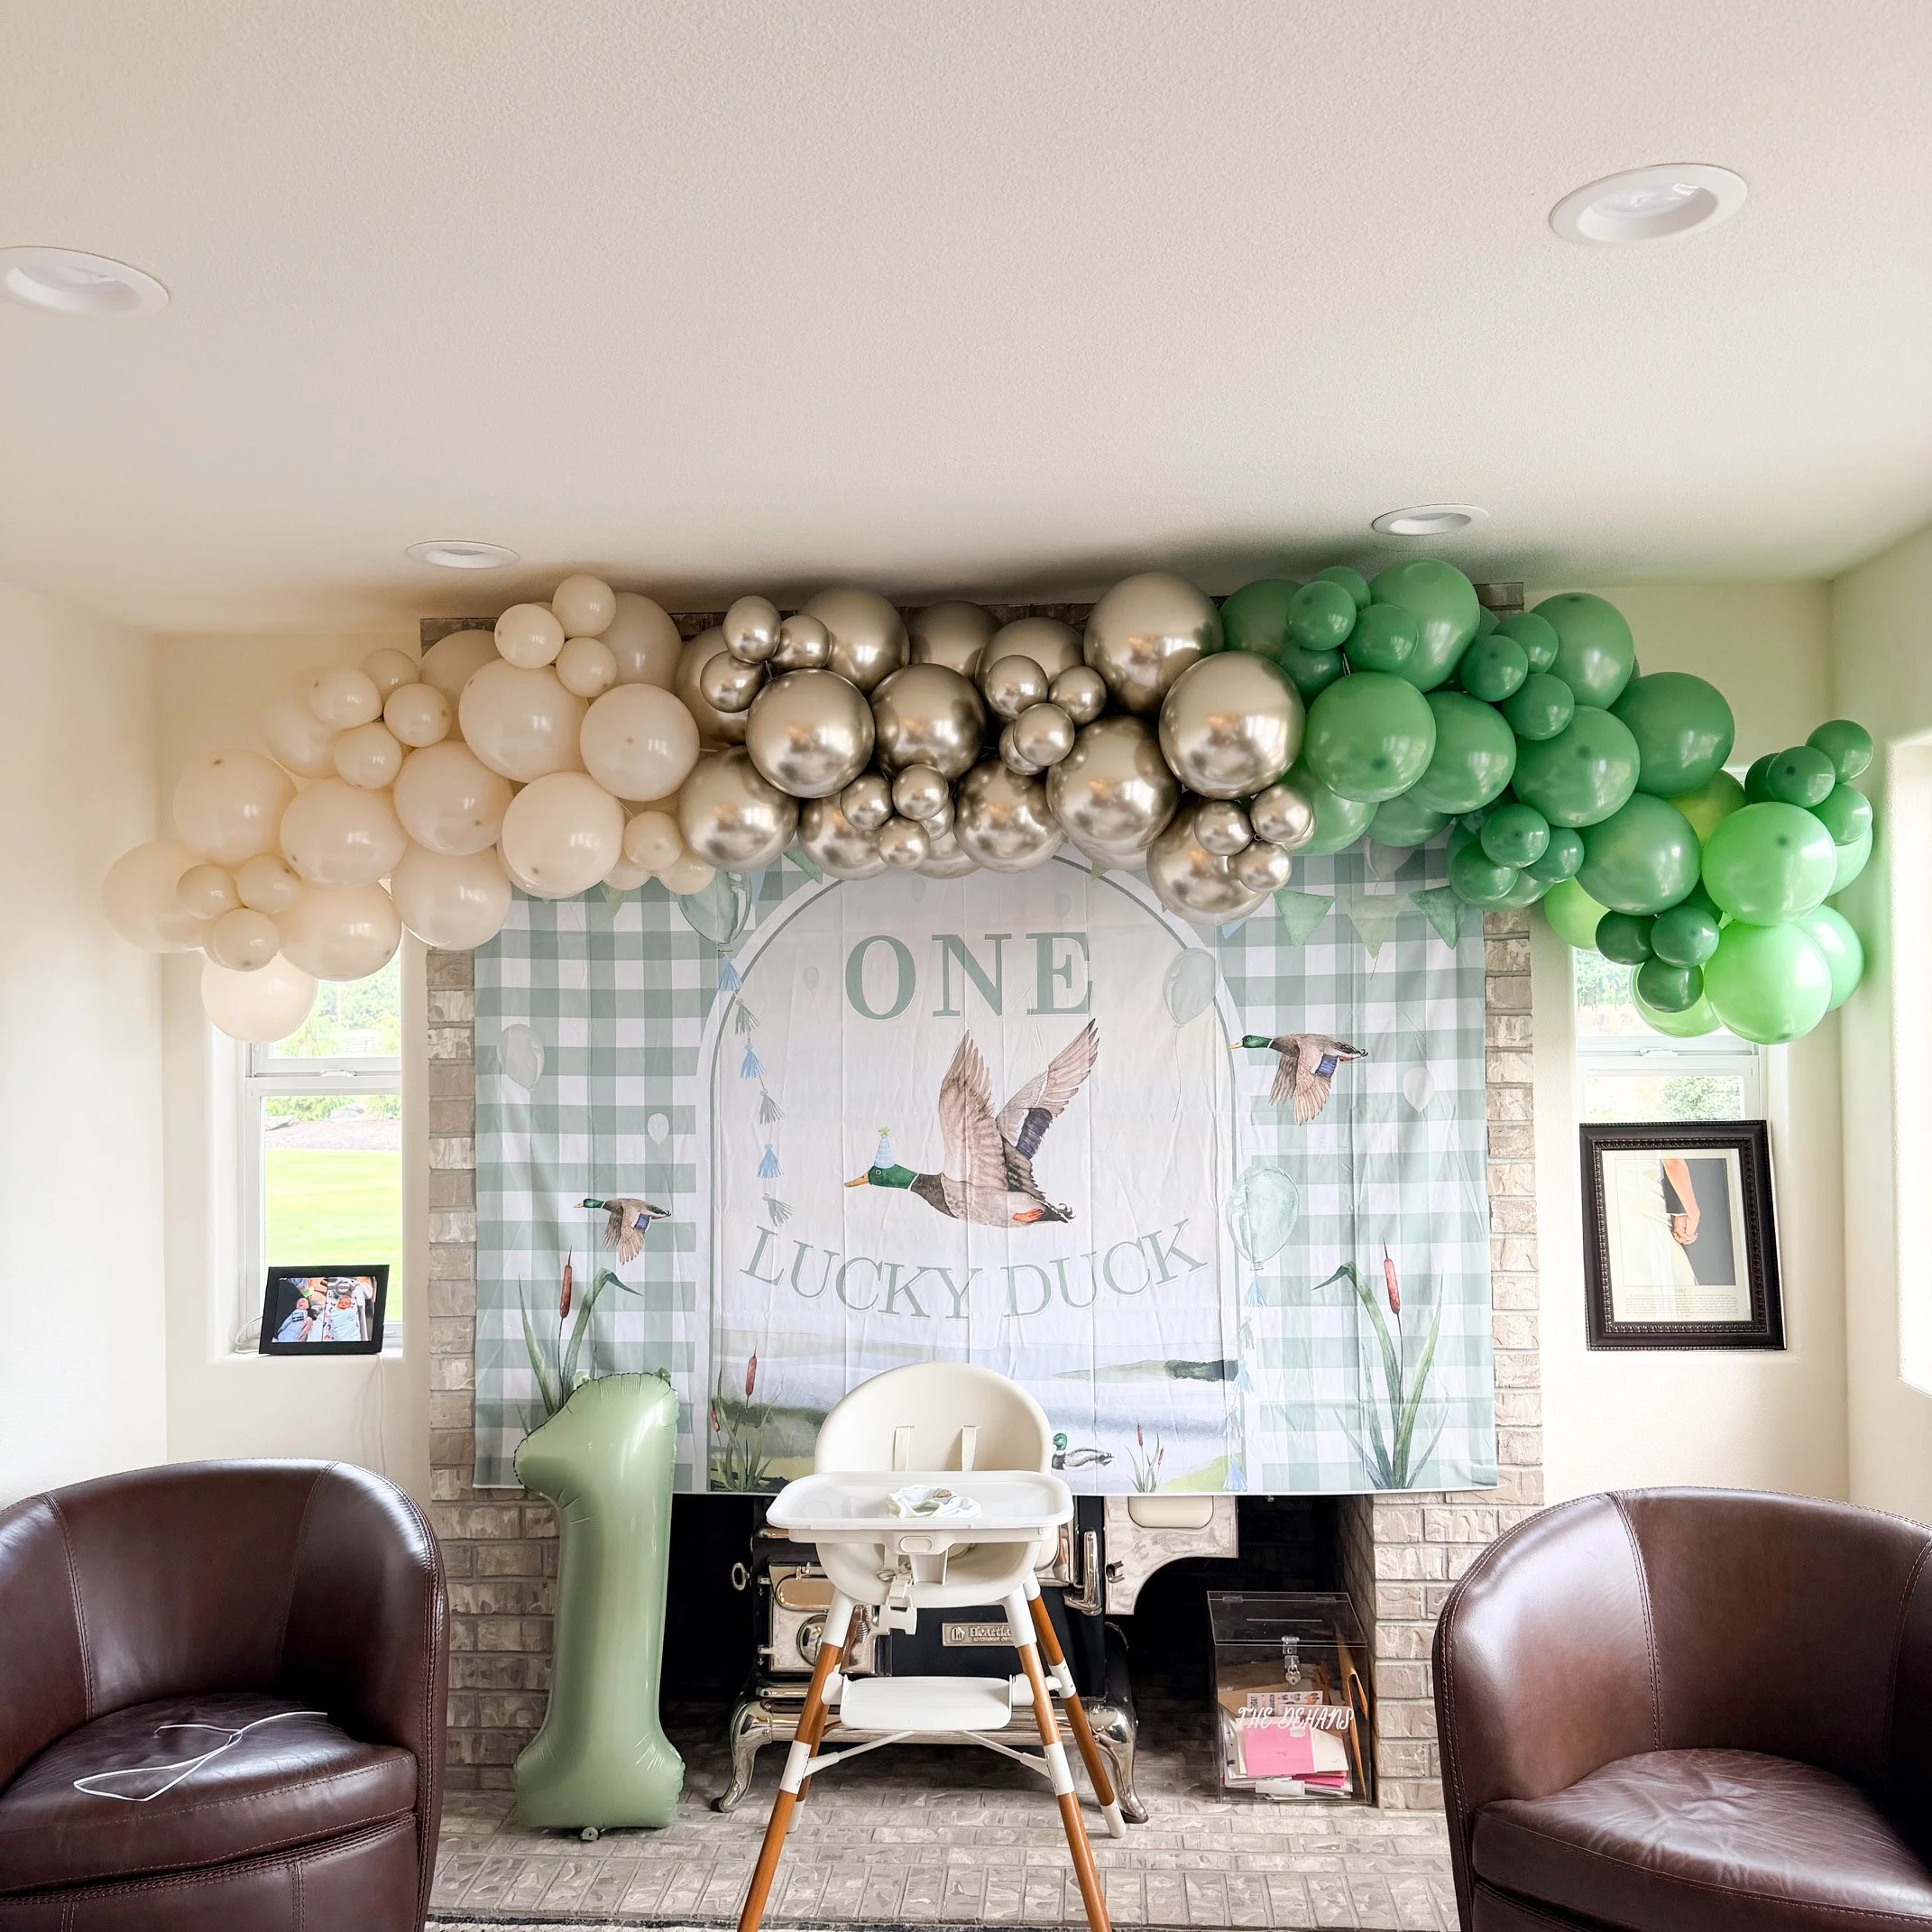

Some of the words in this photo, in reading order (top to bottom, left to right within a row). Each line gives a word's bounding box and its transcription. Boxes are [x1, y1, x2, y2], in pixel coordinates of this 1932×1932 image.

[844, 932, 1095, 1020] ONE
[741, 1224, 979, 1319] LUCKY
[1003, 1218, 1208, 1319] DUCK
[969, 1625, 1012, 1637] Heartla
[1237, 1706, 1274, 1730] THE
